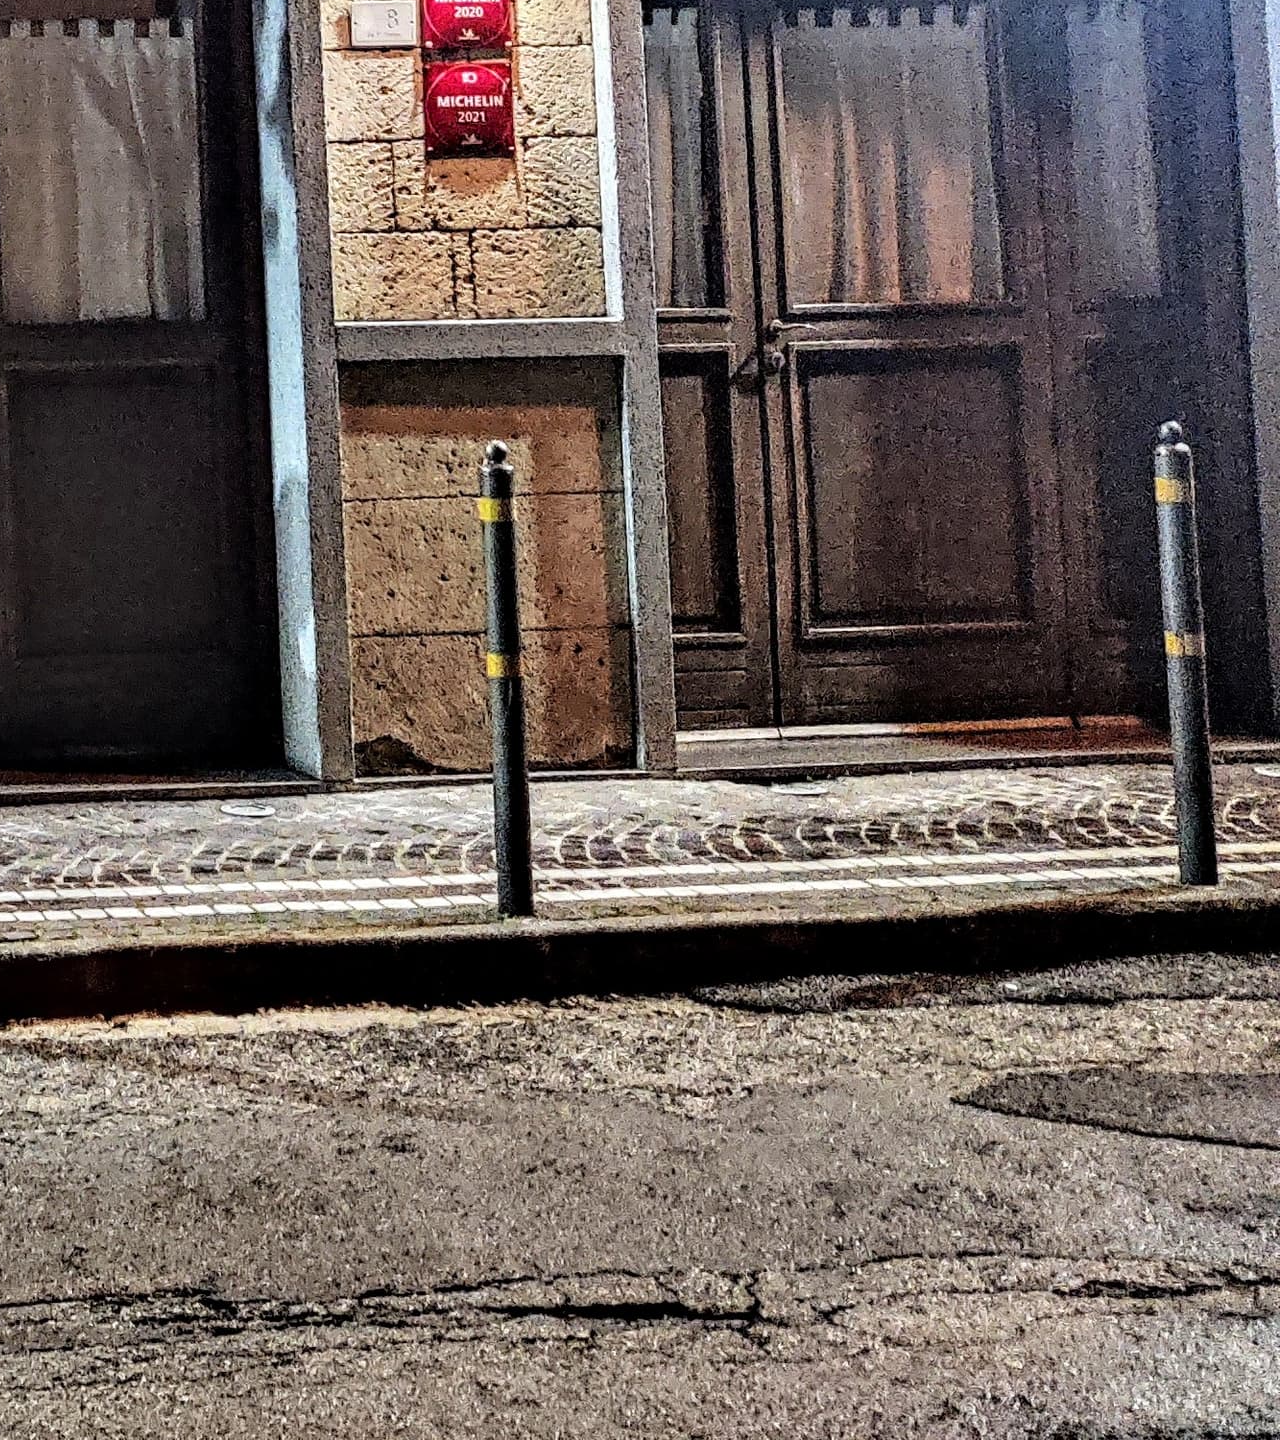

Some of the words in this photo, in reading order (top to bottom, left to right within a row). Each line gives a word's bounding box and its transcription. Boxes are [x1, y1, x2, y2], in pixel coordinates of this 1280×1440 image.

[454, 6, 484, 18] 2020
[437, 95, 504, 107] MICHELIN
[457, 111, 486, 123] 2021
